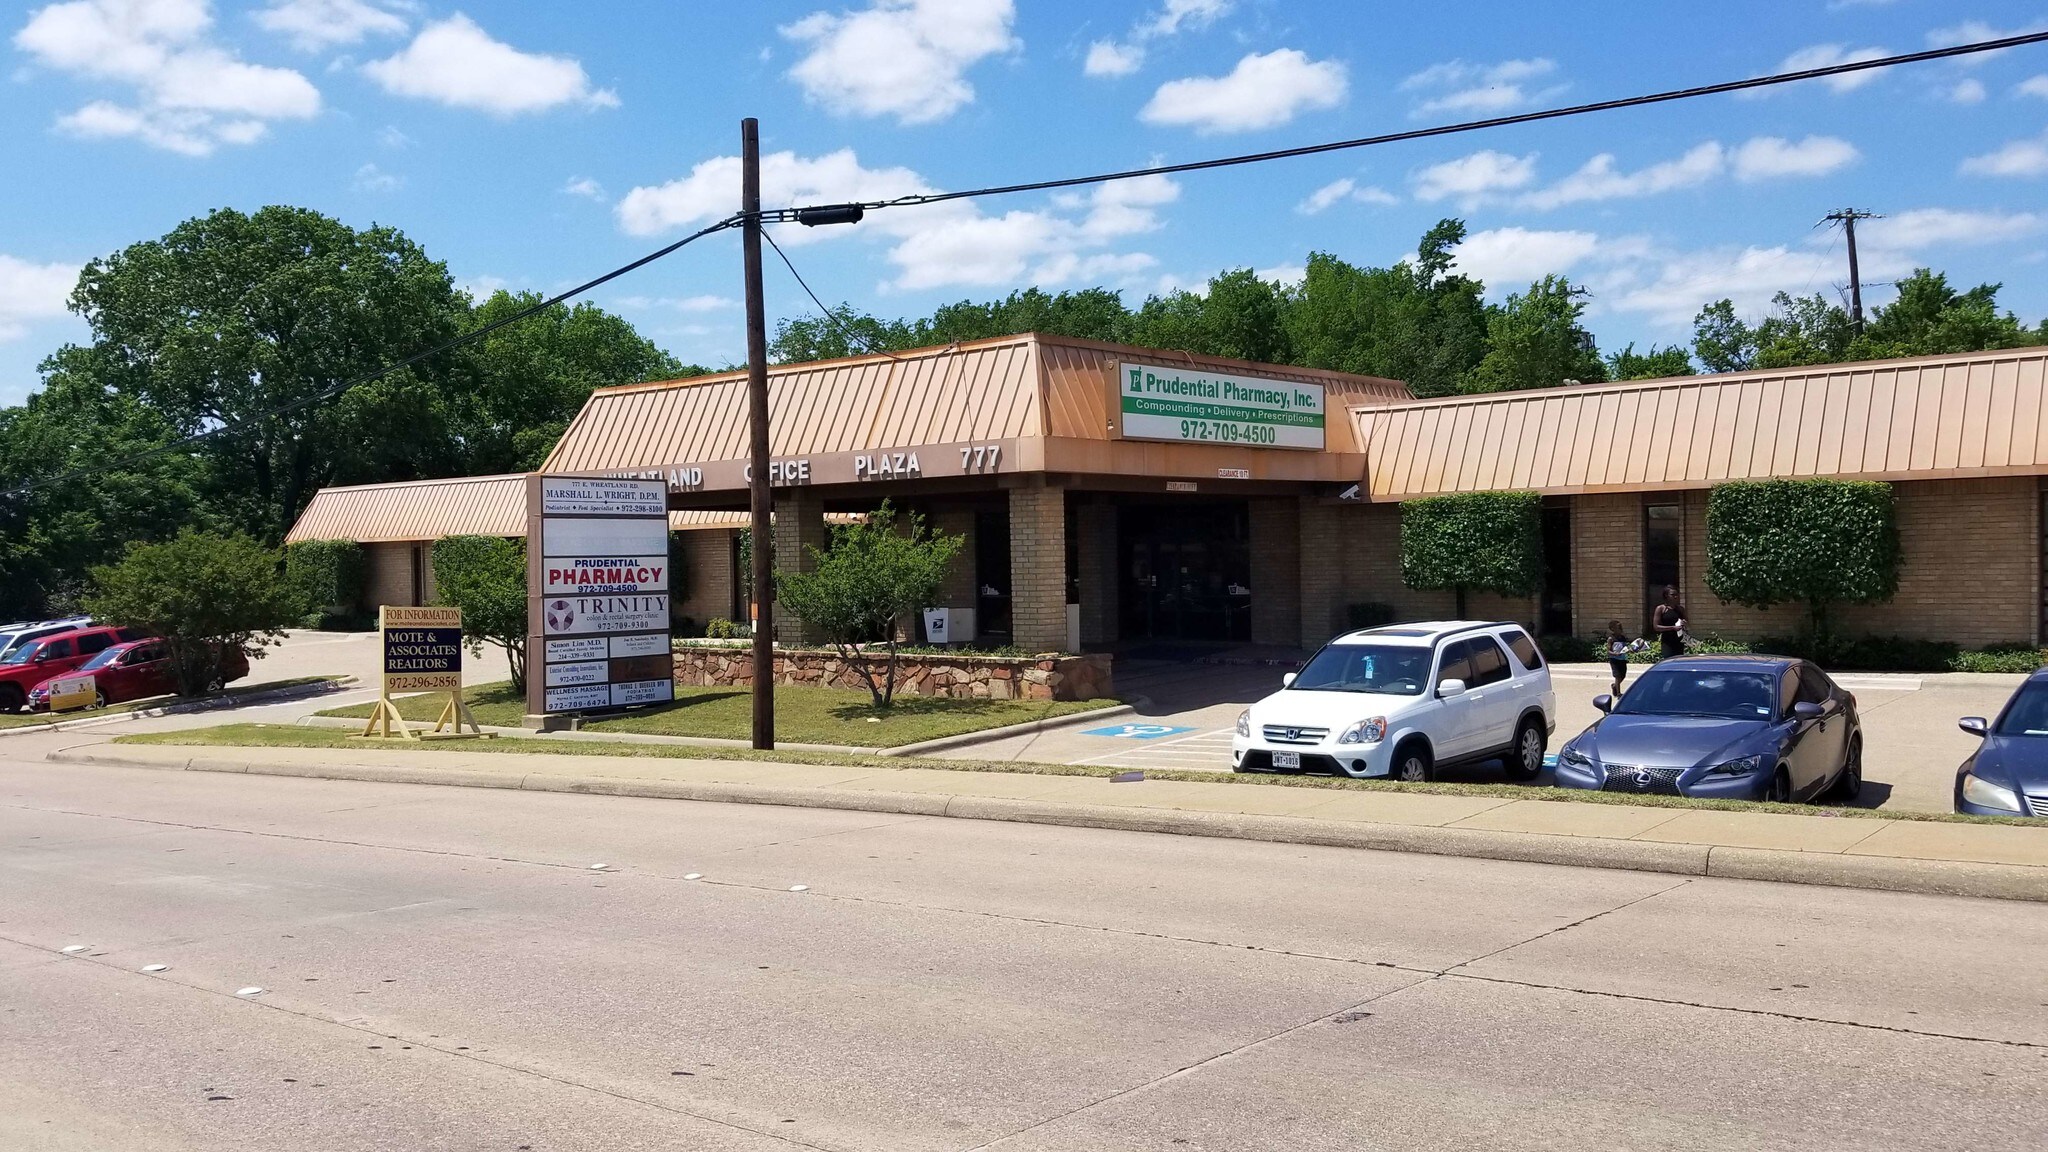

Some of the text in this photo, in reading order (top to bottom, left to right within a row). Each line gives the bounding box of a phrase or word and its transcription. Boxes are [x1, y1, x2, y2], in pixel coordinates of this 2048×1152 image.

[1146, 373, 1316, 408] Prudential Pharmacy, Inc.
[1135, 399, 1314, 423] Compounding Delivery Prescriptions
[1181, 420, 1276, 444] 972-709-4500
[743, 459, 809, 482] OFICE
[854, 451, 920, 476] PLAZA
[960, 445, 1000, 469] 777
[546, 489, 660, 501] MARSHALL L. WRIGHT, D.P.M.
[590, 504, 614, 512] Specialist
[621, 505, 663, 513] 972-298-8100
[574, 559, 641, 568] PRUDENTIAL
[549, 567, 663, 585] PHARMACY
[578, 584, 638, 593] 972-709-4500
[576, 596, 667, 614] TRINITY
[386, 609, 459, 620] FOR INFORMATION
[597, 621, 649, 630] 972-709-9300
[388, 632, 437, 643] MOTE &
[388, 645, 457, 656] ASSOCIATES
[388, 658, 448, 669] REALTORS
[389, 676, 457, 689] 972-296-2856
[546, 685, 608, 696] WELLNESS MASSAGE
[548, 699, 607, 710] 972-709-6474
